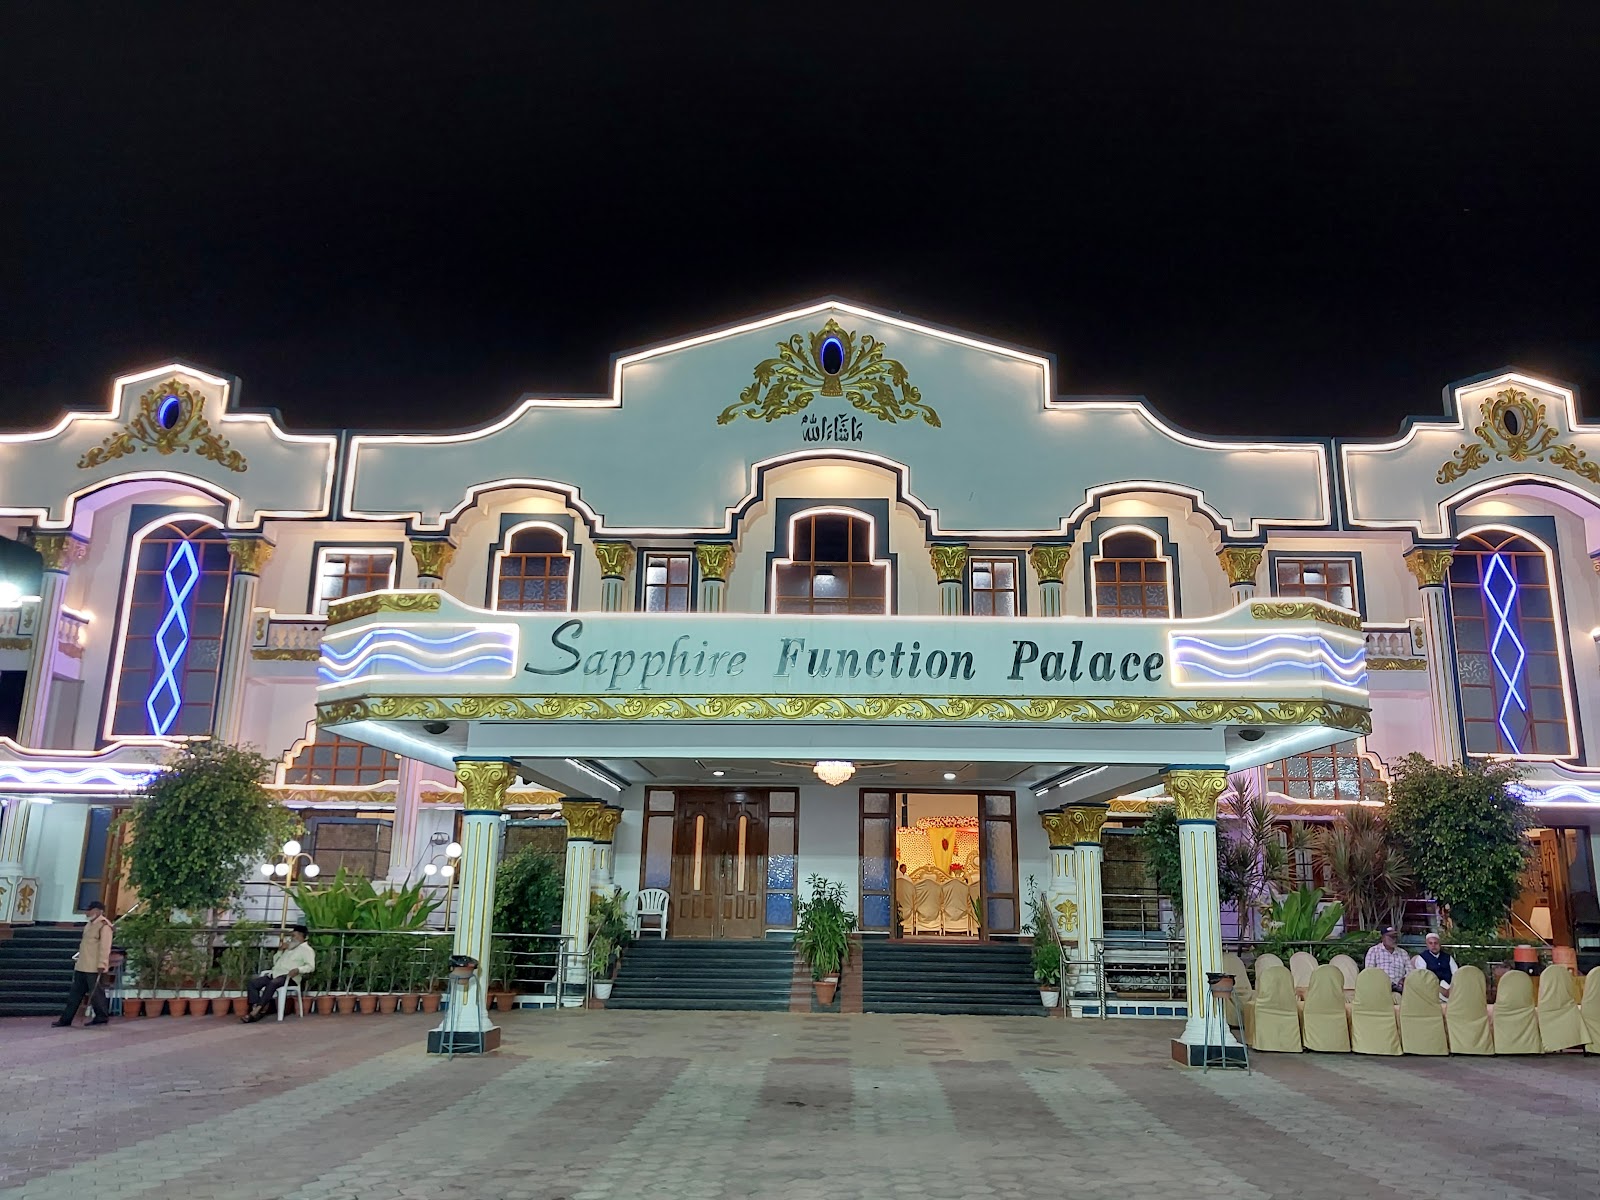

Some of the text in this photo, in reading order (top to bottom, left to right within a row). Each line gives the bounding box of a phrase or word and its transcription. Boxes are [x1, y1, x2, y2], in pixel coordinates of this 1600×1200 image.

[523, 618, 1164, 691] Sapphire Function Palace
